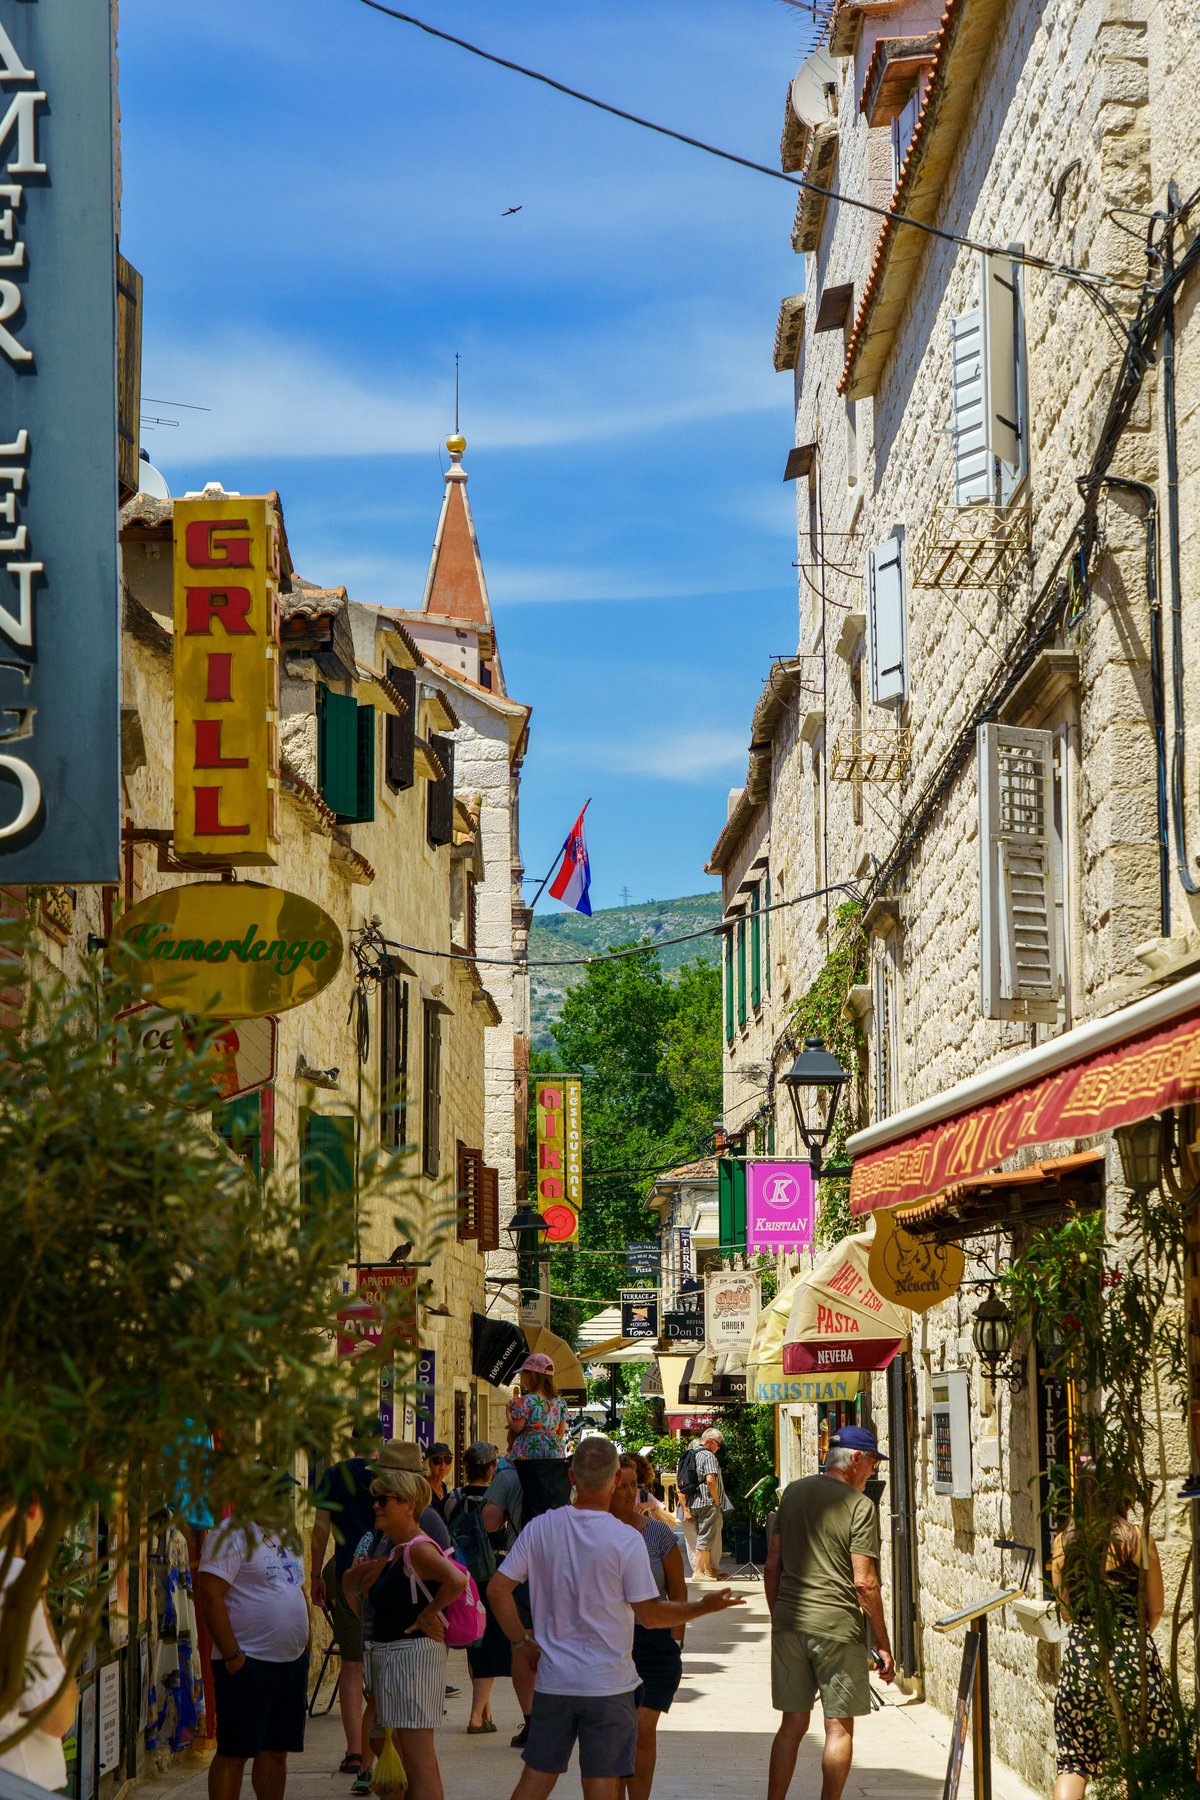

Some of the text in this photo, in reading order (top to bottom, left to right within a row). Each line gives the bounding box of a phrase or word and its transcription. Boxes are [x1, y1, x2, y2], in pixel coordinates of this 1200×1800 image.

[186, 518, 256, 836] GRILL
[118, 923, 332, 977] Kamerlengo
[538, 1086, 563, 1198] alka
[569, 1086, 580, 1198] restaurant
[754, 1218, 808, 1232] KRISTIAN
[827, 1259, 883, 1313] MEAT FISH
[721, 1321, 745, 1331] GARDEN
[817, 1304, 860, 1334] PASTA
[626, 1327, 654, 1337] Toma
[668, 1323, 692, 1337] Don
[817, 1349, 855, 1365] NEVERA
[488, 1359, 504, 1380] 100%
[758, 1381, 847, 1401] KRISTIAN
